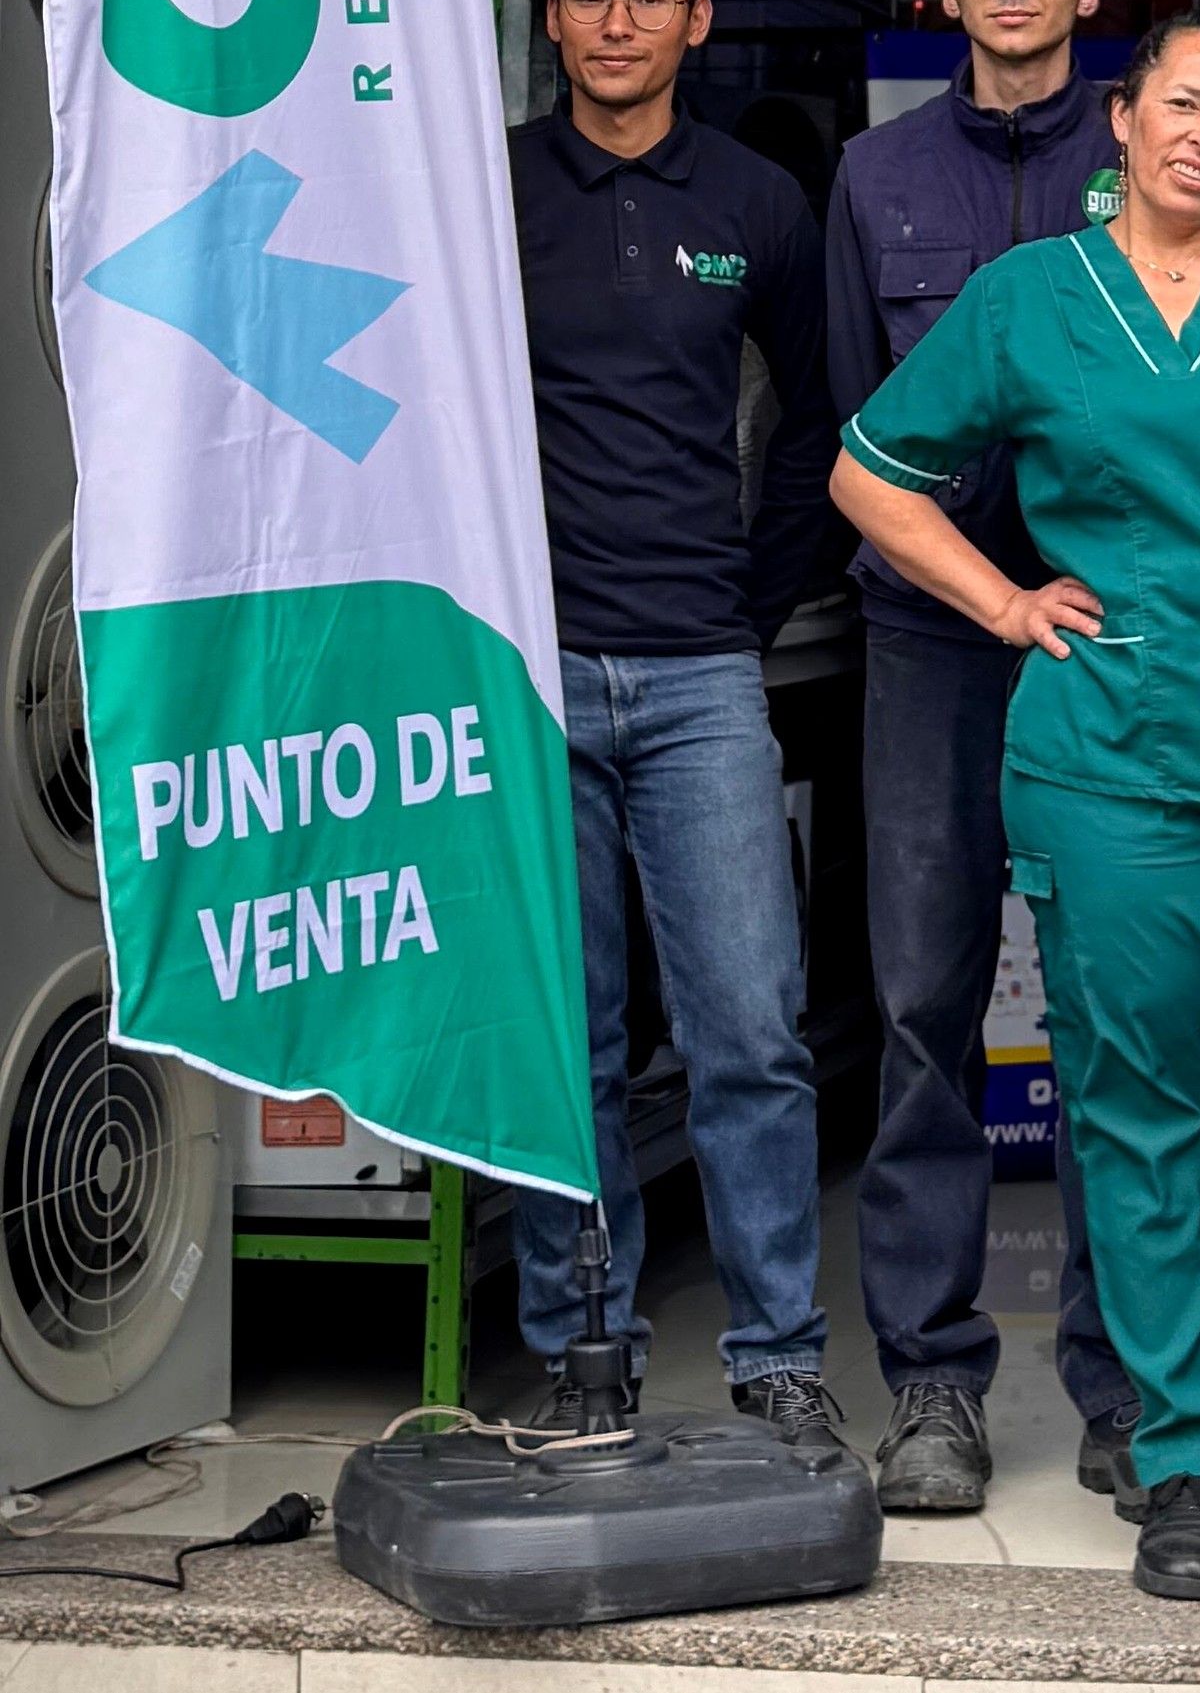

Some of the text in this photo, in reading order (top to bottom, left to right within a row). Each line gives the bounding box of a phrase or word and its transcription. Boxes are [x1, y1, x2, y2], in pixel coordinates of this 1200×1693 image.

[132, 705, 491, 861] PUNTO DE
[198, 865, 439, 1002] VENTA
